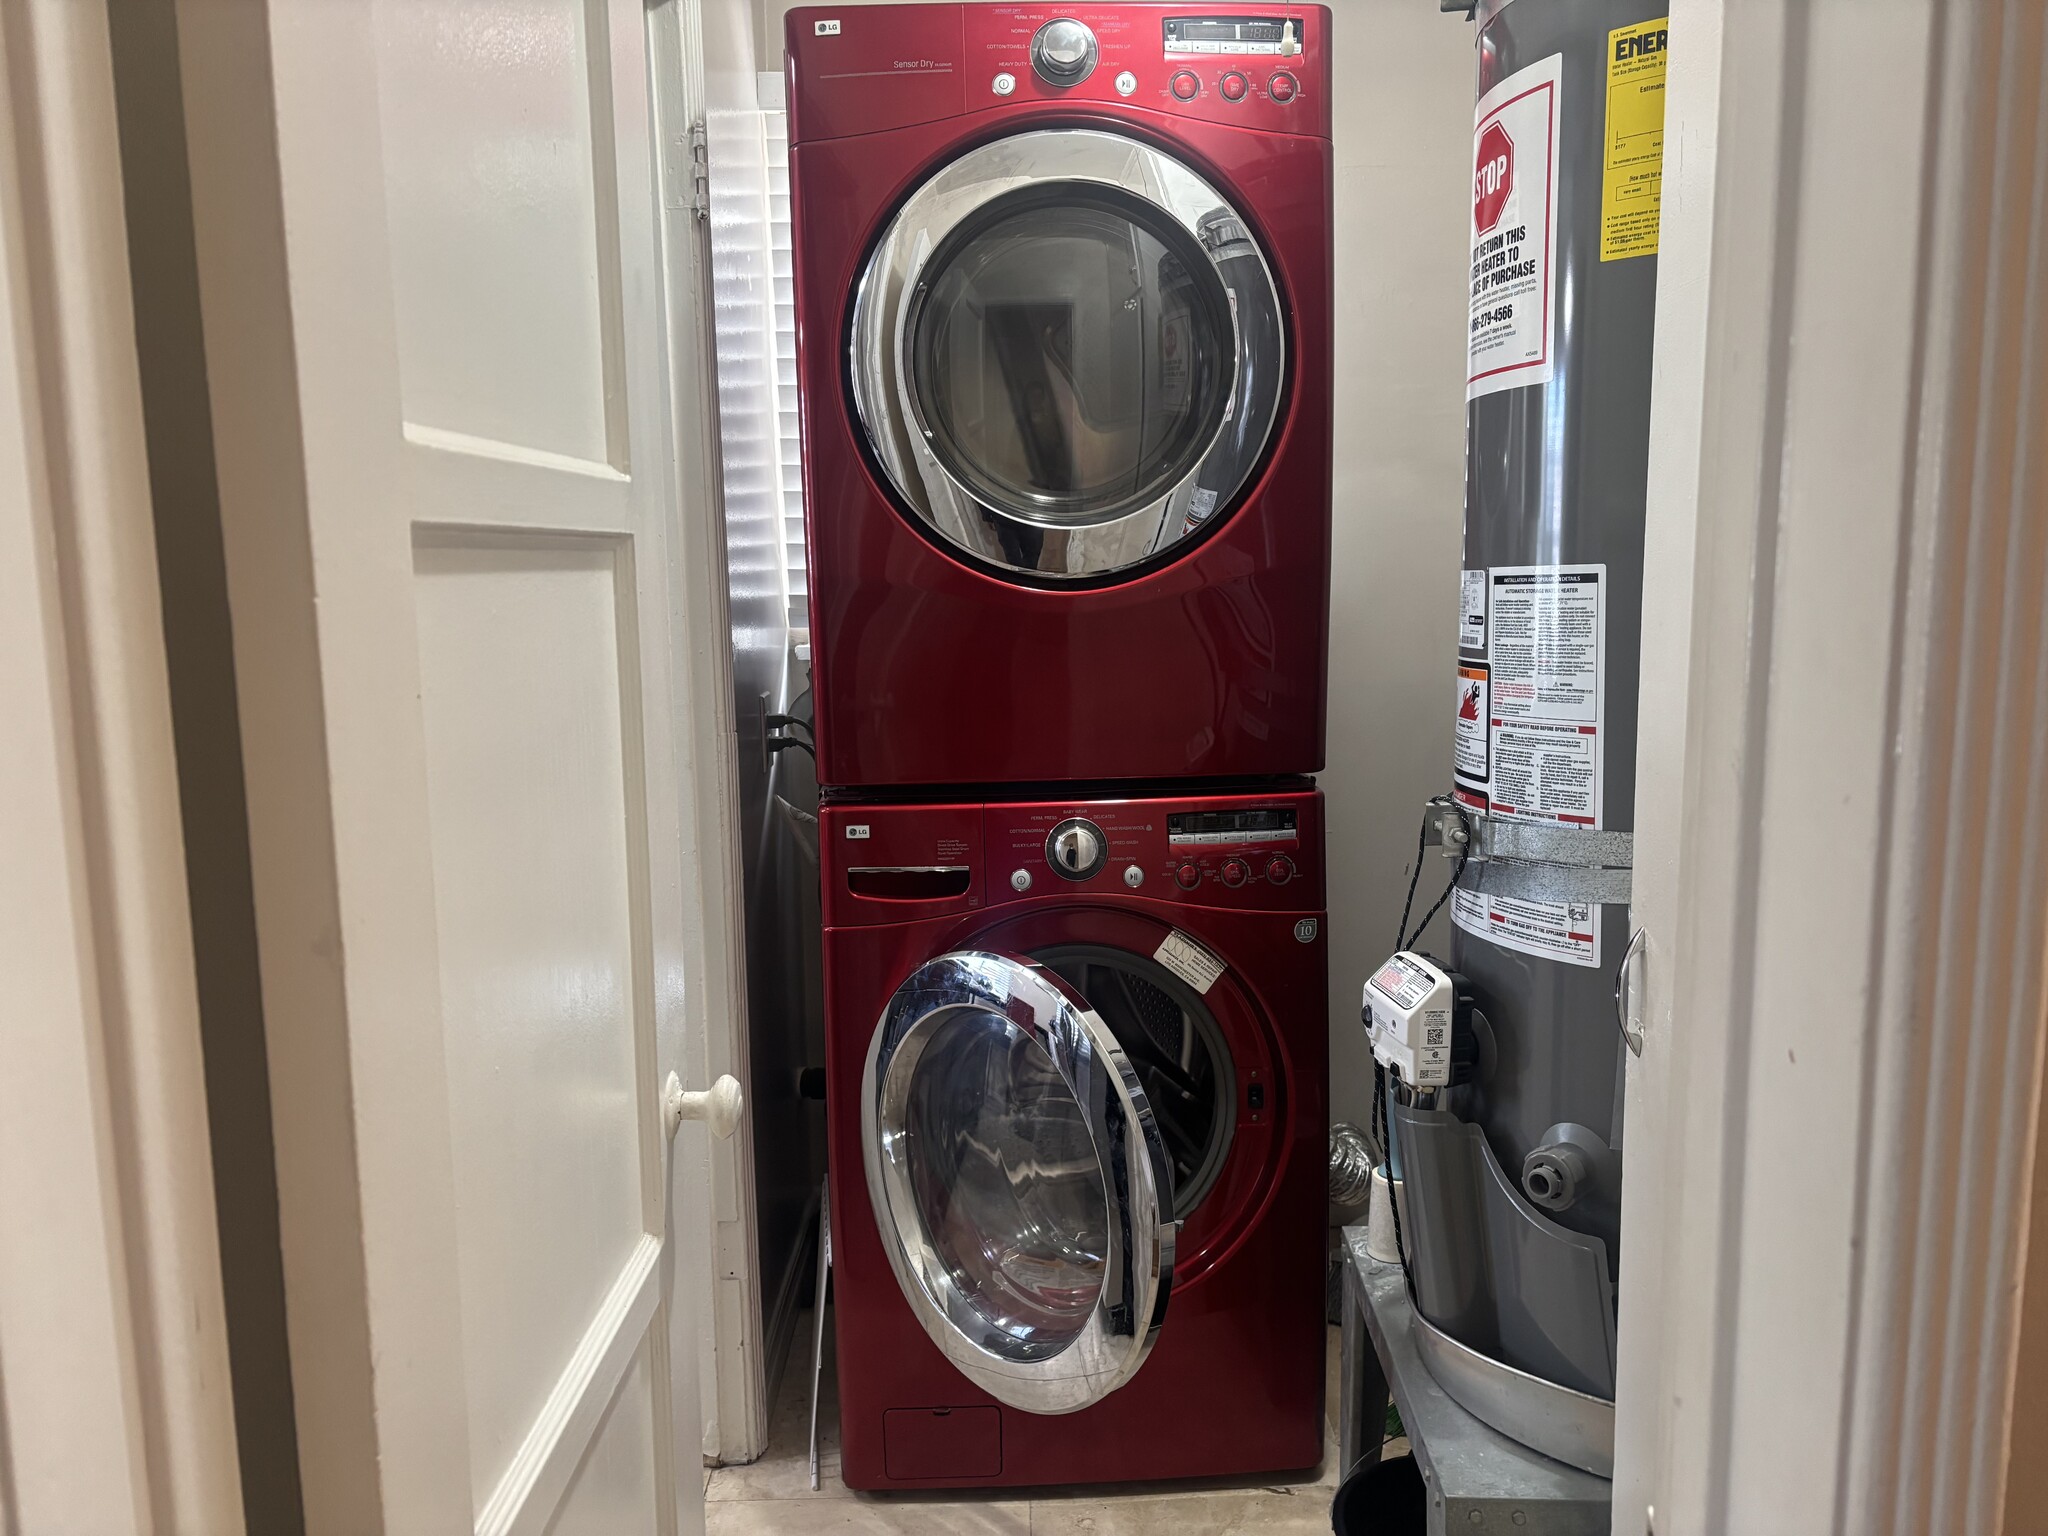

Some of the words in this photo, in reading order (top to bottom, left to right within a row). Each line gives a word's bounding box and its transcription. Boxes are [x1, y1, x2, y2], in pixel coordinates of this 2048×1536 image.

[920, 60, 934, 68] Dry
[1476, 155, 1507, 204] STOP
[1480, 233, 1503, 258] RETURN
[1506, 225, 1525, 245] THIS
[1481, 251, 1505, 274] HEATER
[1508, 246, 1519, 262] TO
[1482, 275, 1489, 291] OF
[1491, 259, 1535, 287] PURCHASE
[1301, 926, 1312, 936] 10
